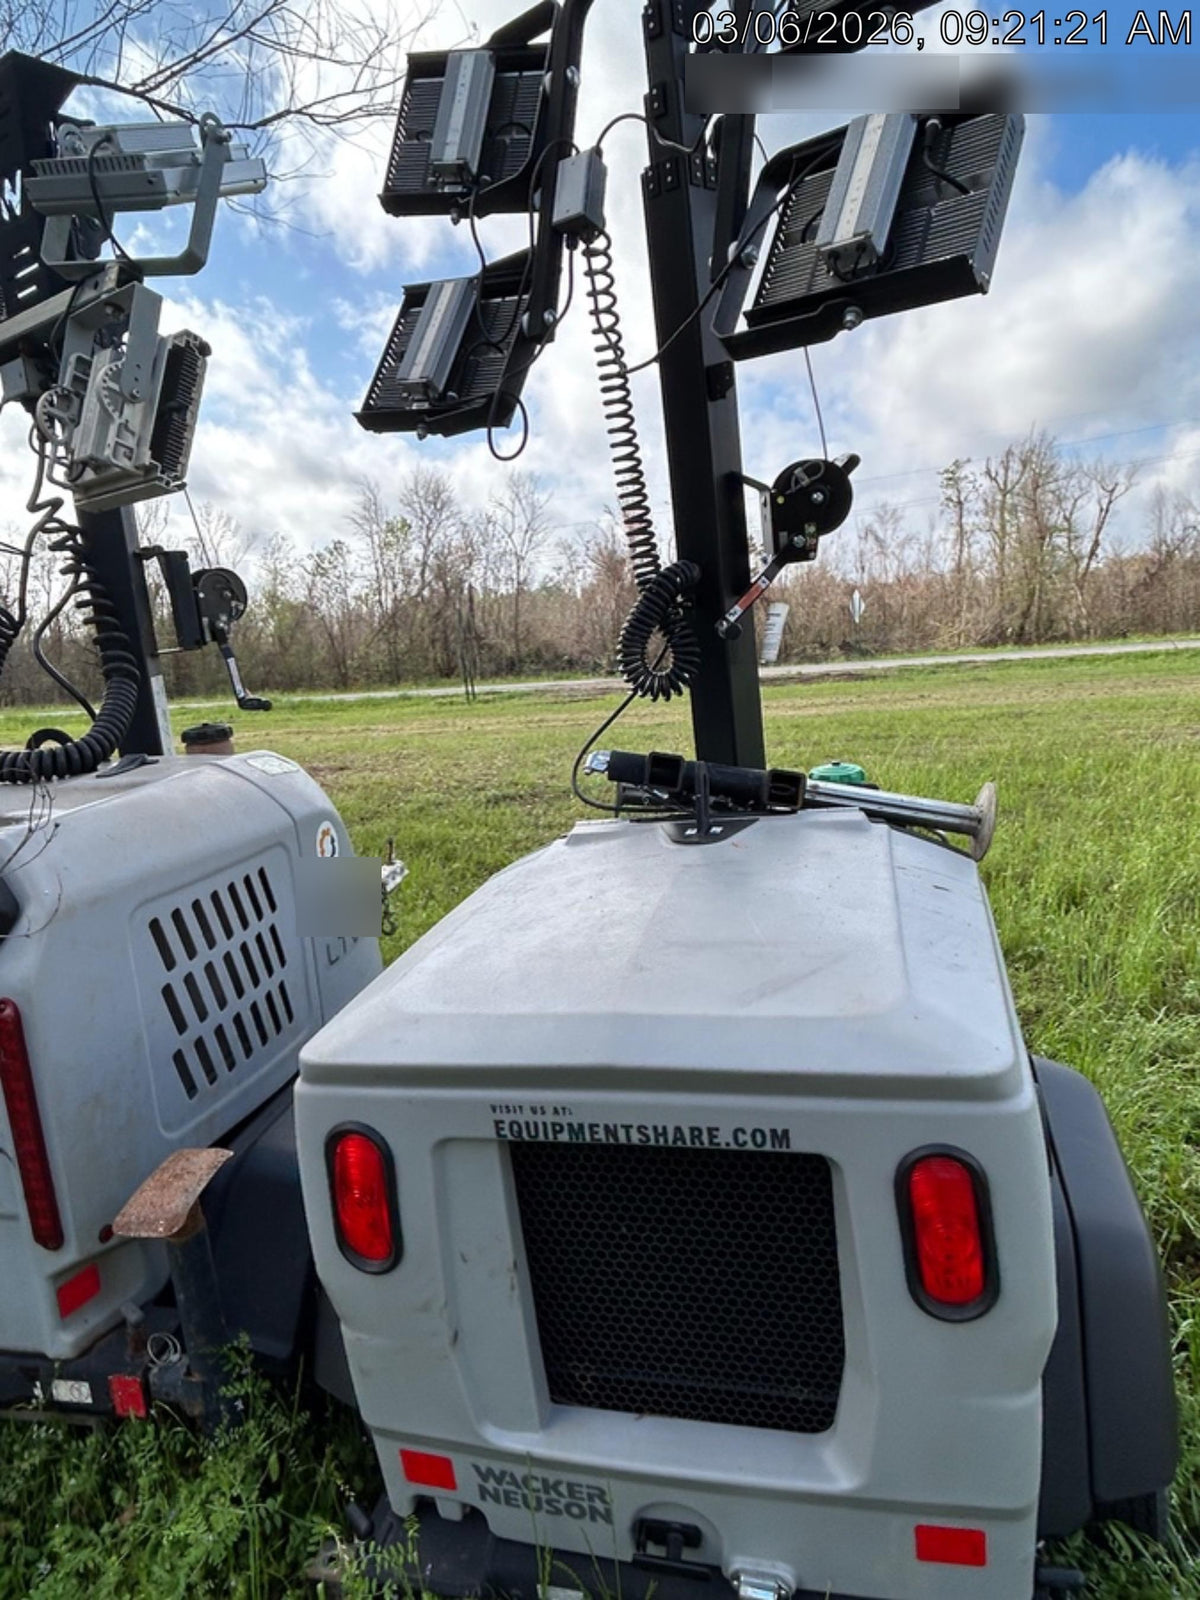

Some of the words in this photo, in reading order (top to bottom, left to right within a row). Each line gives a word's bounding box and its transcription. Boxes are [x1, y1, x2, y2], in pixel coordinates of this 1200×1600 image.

[490, 1104, 524, 1115] VISIT
[530, 1106, 546, 1116] US
[494, 1119, 791, 1149] EQUIPMENTSHARE.COM
[471, 1463, 611, 1505] WACKER
[477, 1483, 613, 1525] NEUSON
